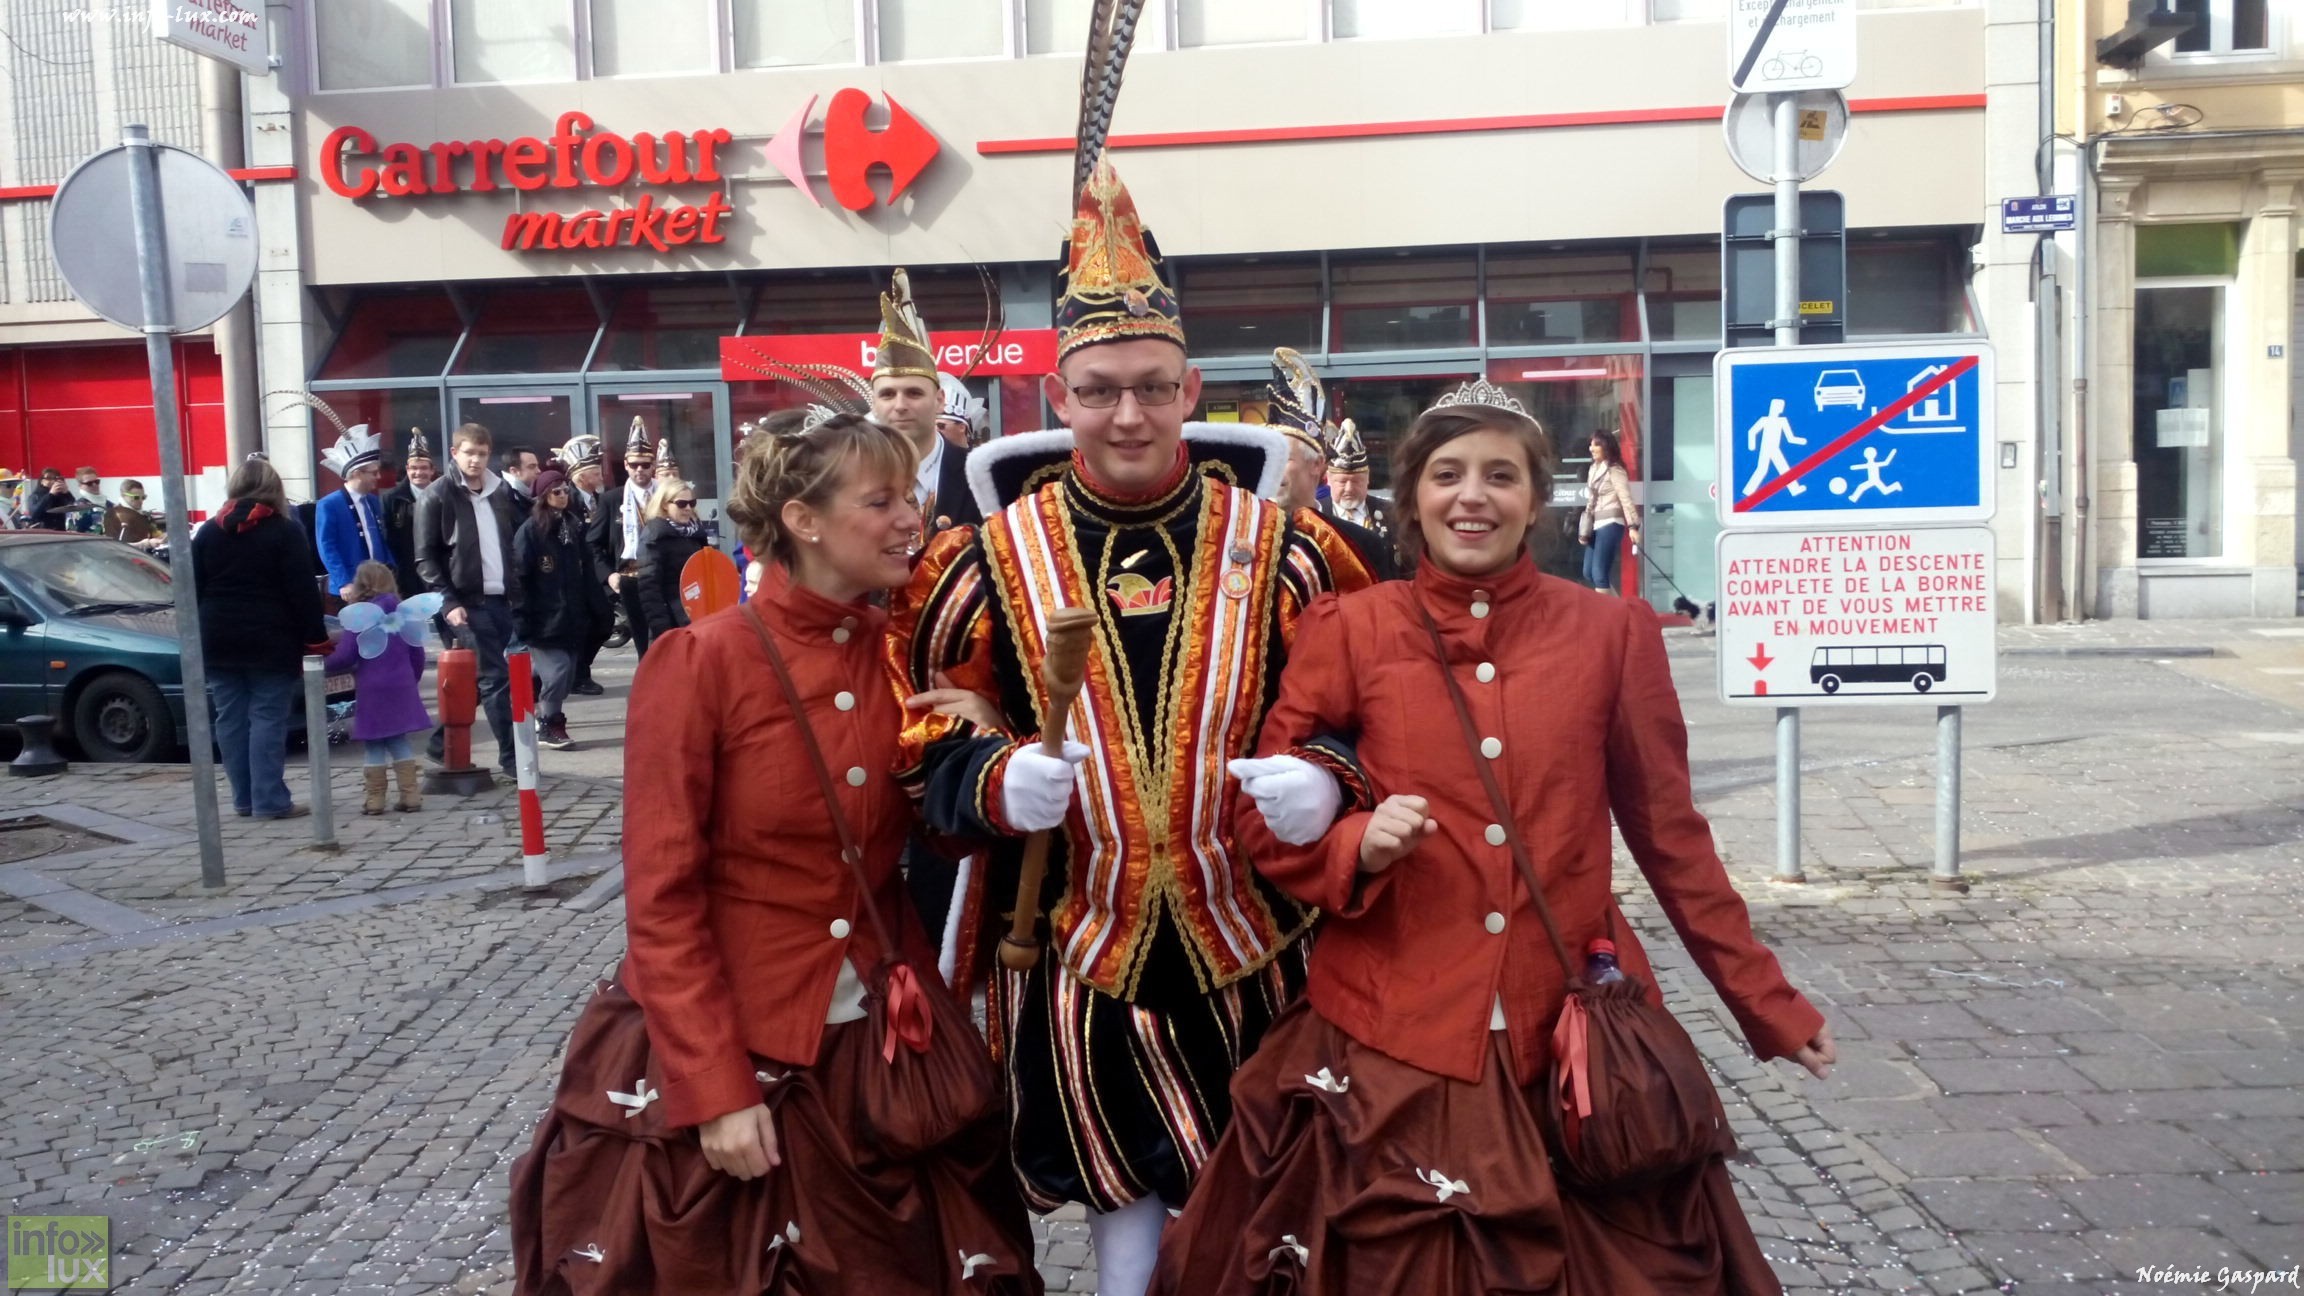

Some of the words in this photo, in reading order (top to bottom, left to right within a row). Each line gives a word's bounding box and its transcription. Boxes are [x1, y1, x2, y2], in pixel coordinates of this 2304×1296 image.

[1748, 16, 1758, 28] et
[1762, 11, 1835, 28] hargement
[190, 19, 248, 51] market
[320, 111, 732, 198] Carrefour
[501, 191, 732, 253] market
[1798, 302, 1832, 310] CELET
[861, 340, 1023, 367] bvenue
[2270, 346, 2281, 356] 14
[1800, 535, 1911, 552] ATTENTION
[1728, 558, 1832, 575] ATTENDRE
[1843, 557, 1867, 572] LA
[1879, 554, 1985, 571] DESCENTE
[1727, 578, 1833, 596] COMPLETE
[1845, 578, 1870, 593] DE
[1881, 577, 1906, 593] LA
[1918, 575, 1986, 592] BORNE
[1727, 600, 1791, 616] AVANT
[1803, 599, 1828, 615] DE
[1840, 598, 1893, 614] VOUS
[1905, 596, 1987, 613] METTRE
[1774, 620, 1799, 636] EN
[1810, 617, 1938, 635] MOUVEMENT
